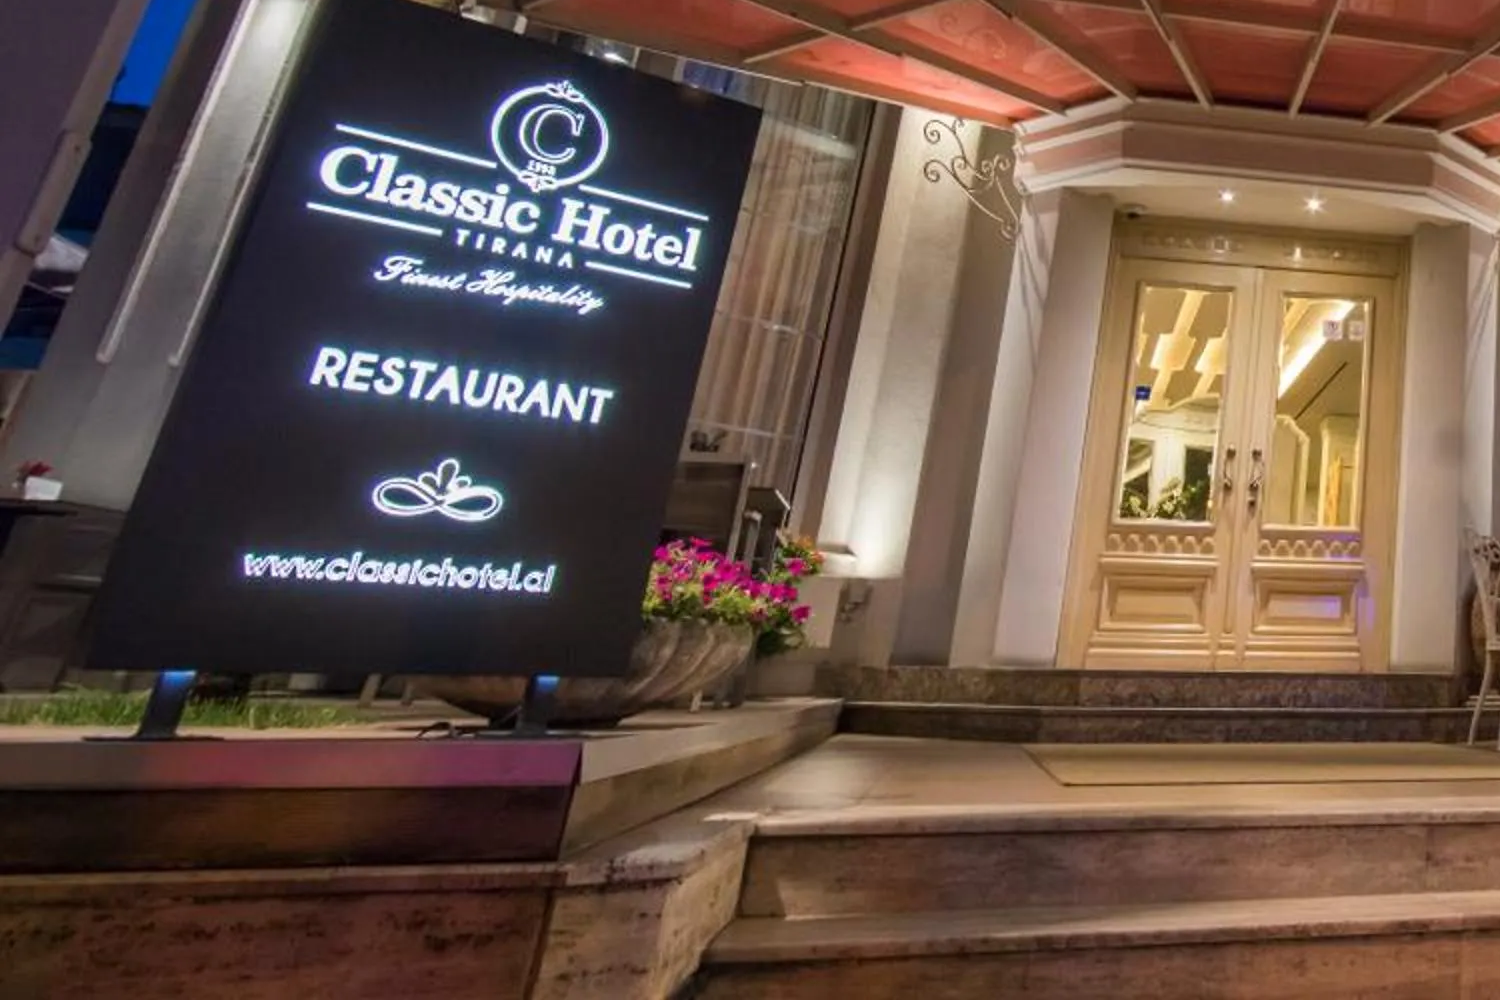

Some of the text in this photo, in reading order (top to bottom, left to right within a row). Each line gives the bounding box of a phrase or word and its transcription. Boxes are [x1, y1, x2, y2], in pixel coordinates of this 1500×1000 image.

[318, 145, 702, 271] Classic Hotel
[454, 228, 575, 269] TIRANA
[372, 255, 605, 316] Finest Hospitality
[309, 346, 613, 424] RESTAURANT
[241, 551, 558, 595] www.classichotel.al
